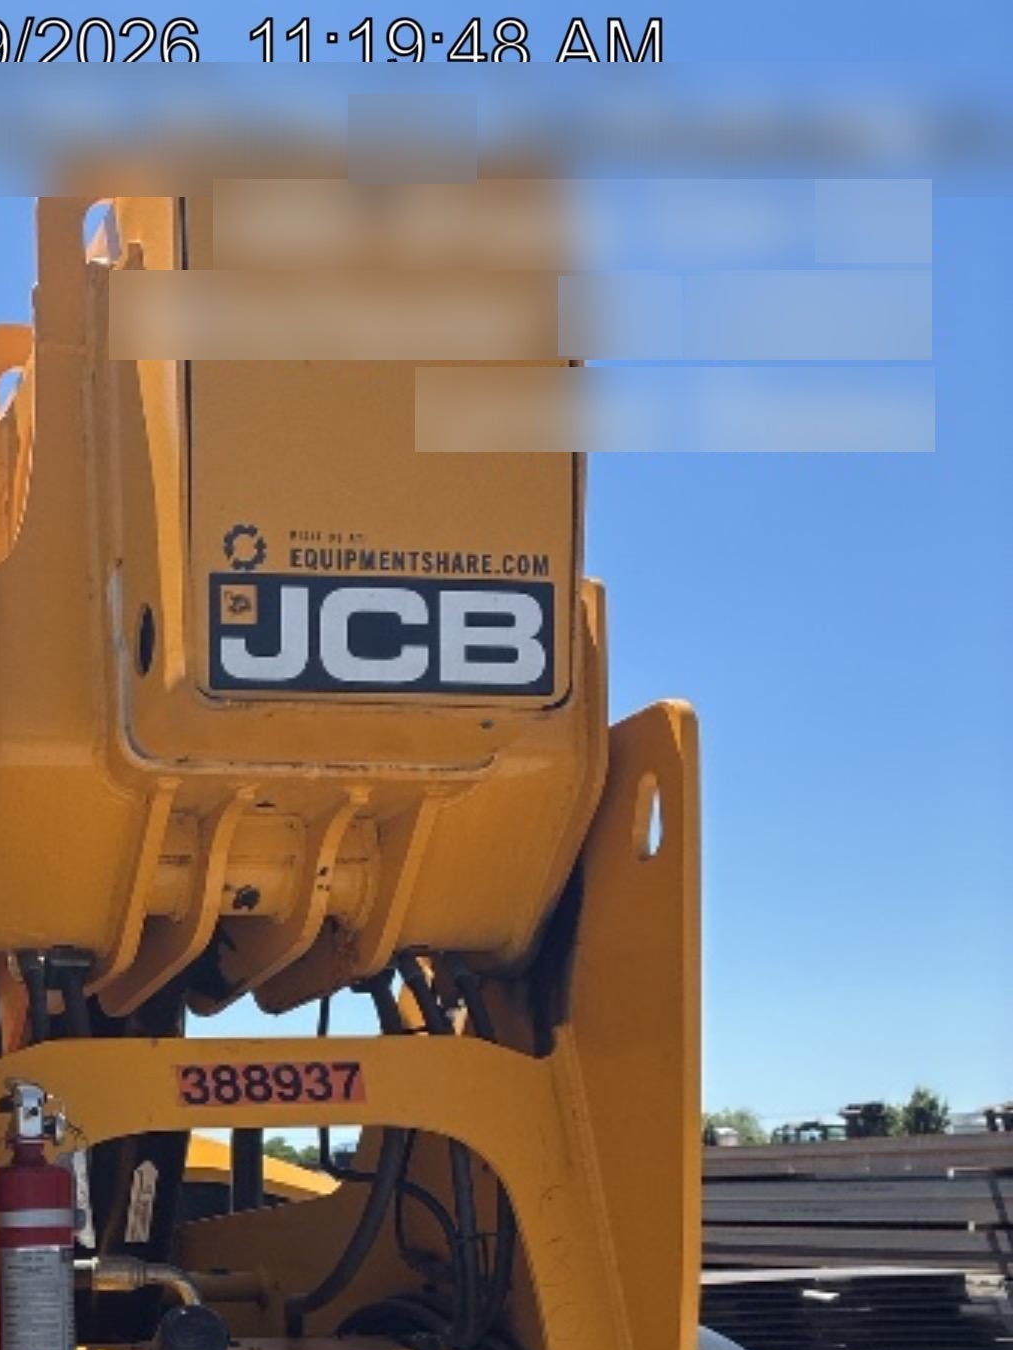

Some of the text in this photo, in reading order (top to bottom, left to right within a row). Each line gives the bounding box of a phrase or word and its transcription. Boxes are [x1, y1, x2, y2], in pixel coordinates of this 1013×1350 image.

[289, 548, 550, 576] EQUIPMENTSHARE.COM
[220, 585, 546, 685] JCB
[181, 1061, 360, 1105] 388937
